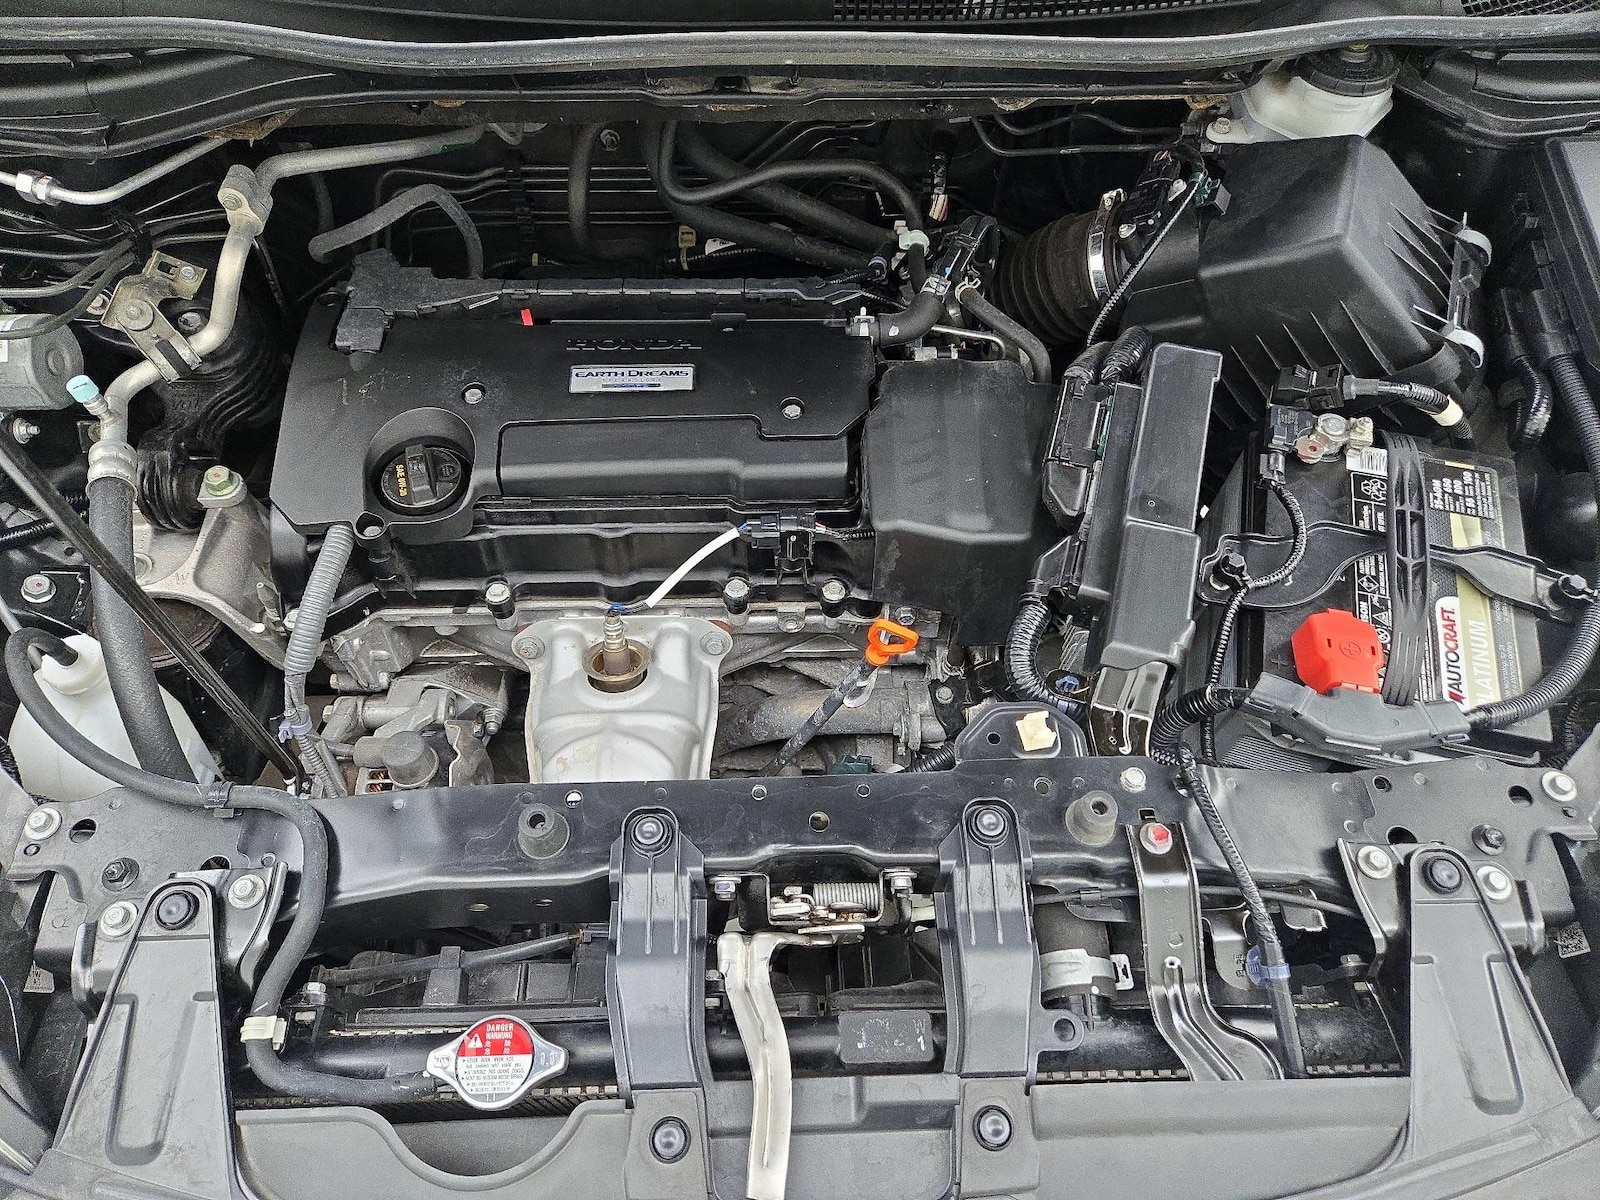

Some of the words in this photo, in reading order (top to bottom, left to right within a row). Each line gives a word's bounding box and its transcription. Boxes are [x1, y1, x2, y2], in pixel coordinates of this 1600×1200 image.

[566, 338, 702, 350] HONDA
[628, 369, 689, 378] DREAMS
[396, 464, 405, 478] SAE
[1442, 478, 1452, 493] 650
[1432, 479, 1444, 510] 35-AGM
[1441, 606, 1463, 693] AUTOCRAFT
[486, 1023, 514, 1032] DANGER
